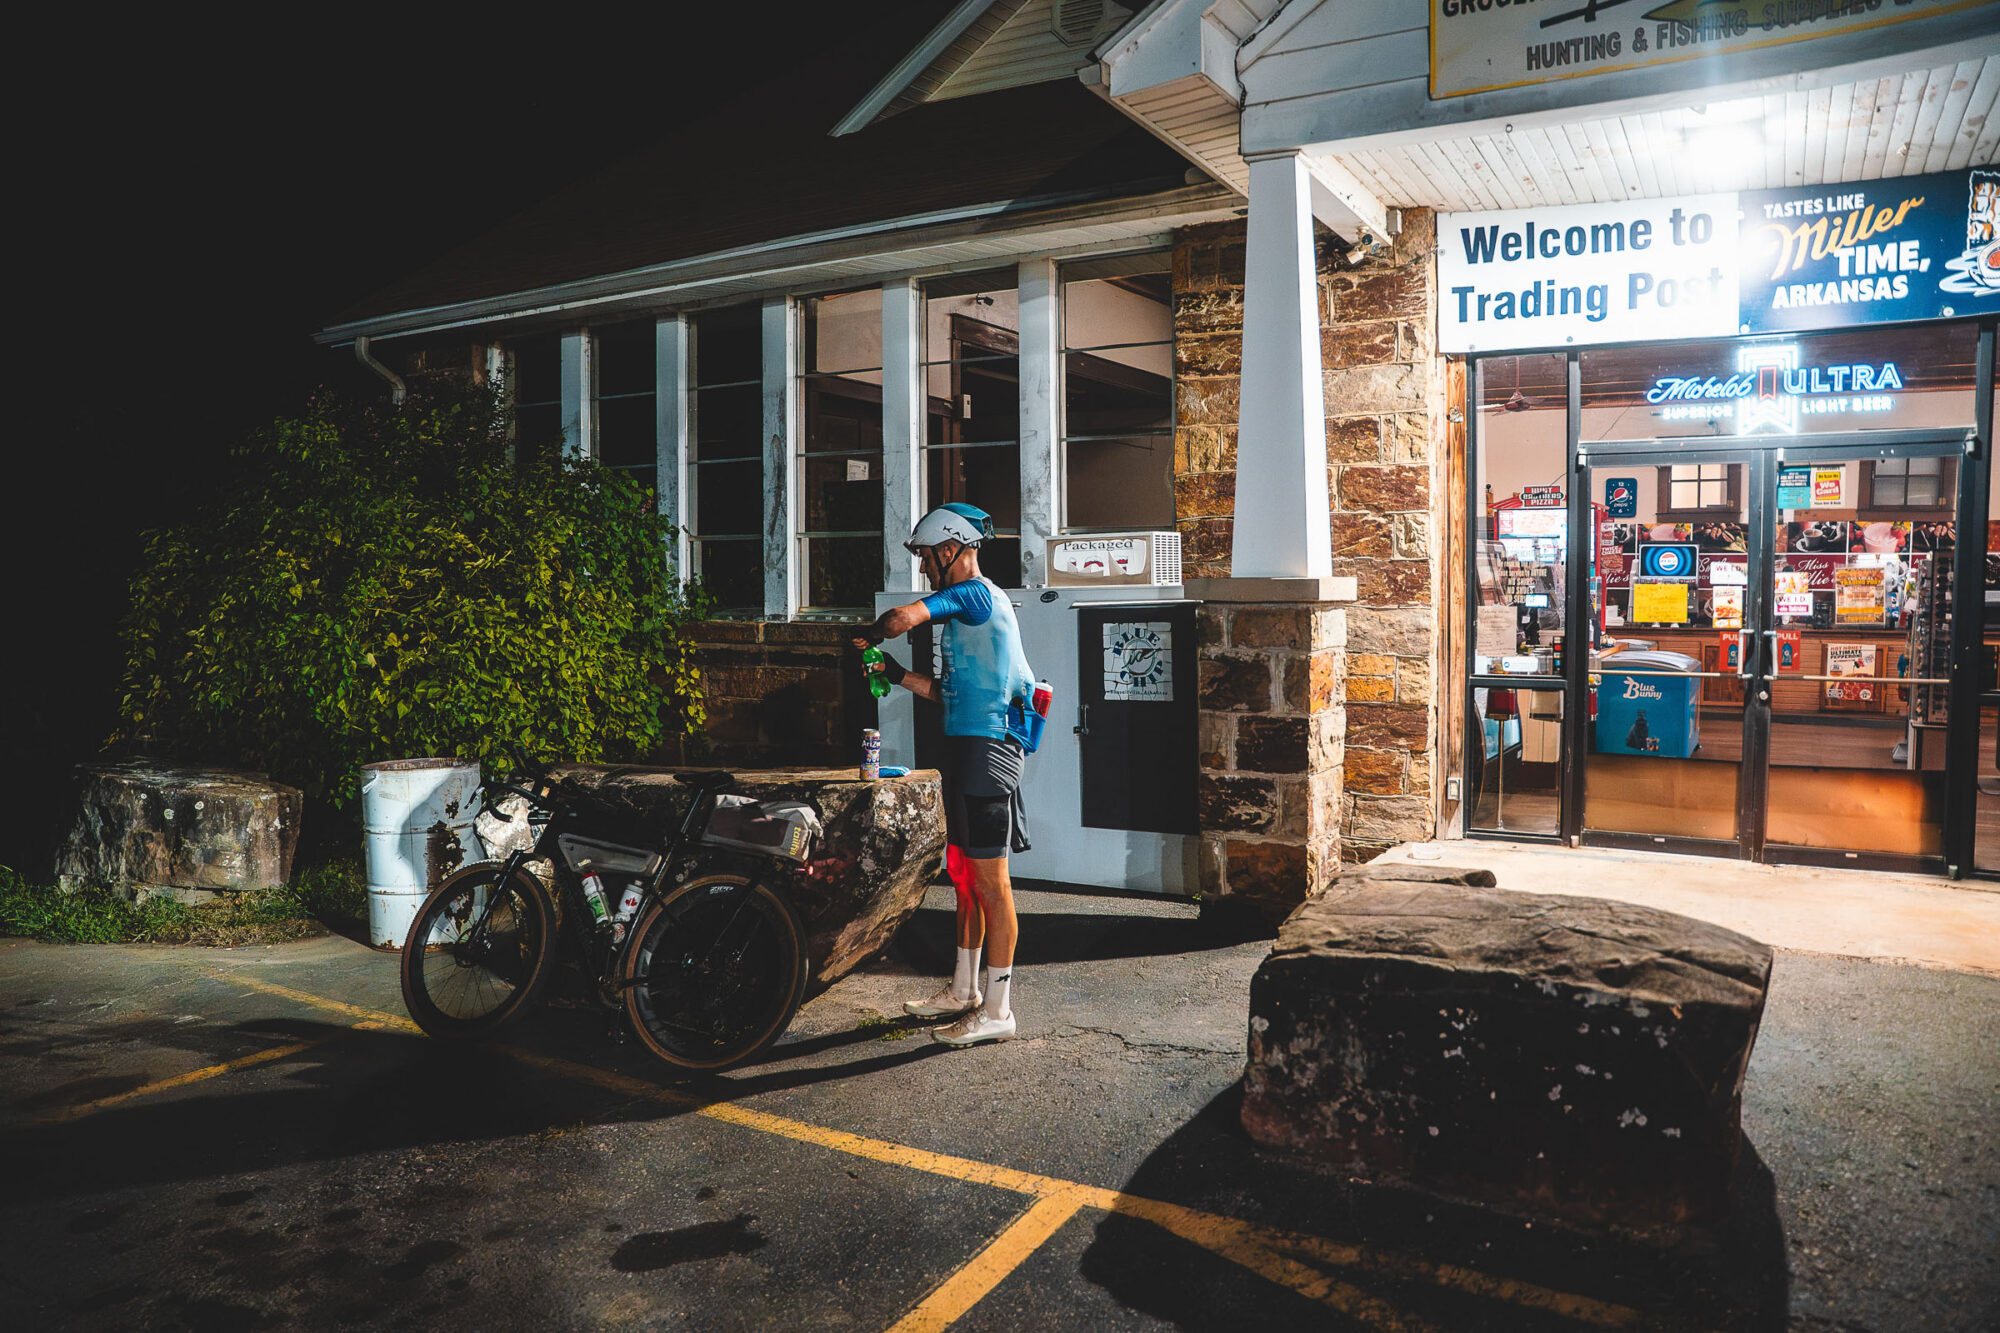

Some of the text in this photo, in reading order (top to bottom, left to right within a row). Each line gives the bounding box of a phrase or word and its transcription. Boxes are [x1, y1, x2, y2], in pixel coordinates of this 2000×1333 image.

[1526, 32, 1622, 71] HUNTING
[1632, 27, 1648, 52] &
[1656, 8, 1748, 50] FISHING
[1764, 193, 1865, 219] TASTES LIKE
[1460, 208, 1713, 265] Welcome to
[1754, 196, 1925, 280] Miller
[1834, 240, 1931, 277] TIME,
[1451, 267, 1724, 323] Trading Post
[1772, 275, 1909, 309] ARKANSAS
[1647, 362, 1902, 404] Michelob ULTRA
[1663, 396, 1895, 420] SUPERIOR LIGHT BEER
[1063, 540, 1134, 552] Packaged
[1797, 557, 1829, 572] Miss
[1112, 627, 1160, 656] BLUE
[1723, 633, 1739, 641] PUL
[1120, 660, 1163, 687] CHIP
[1623, 676, 1655, 698] Blue
